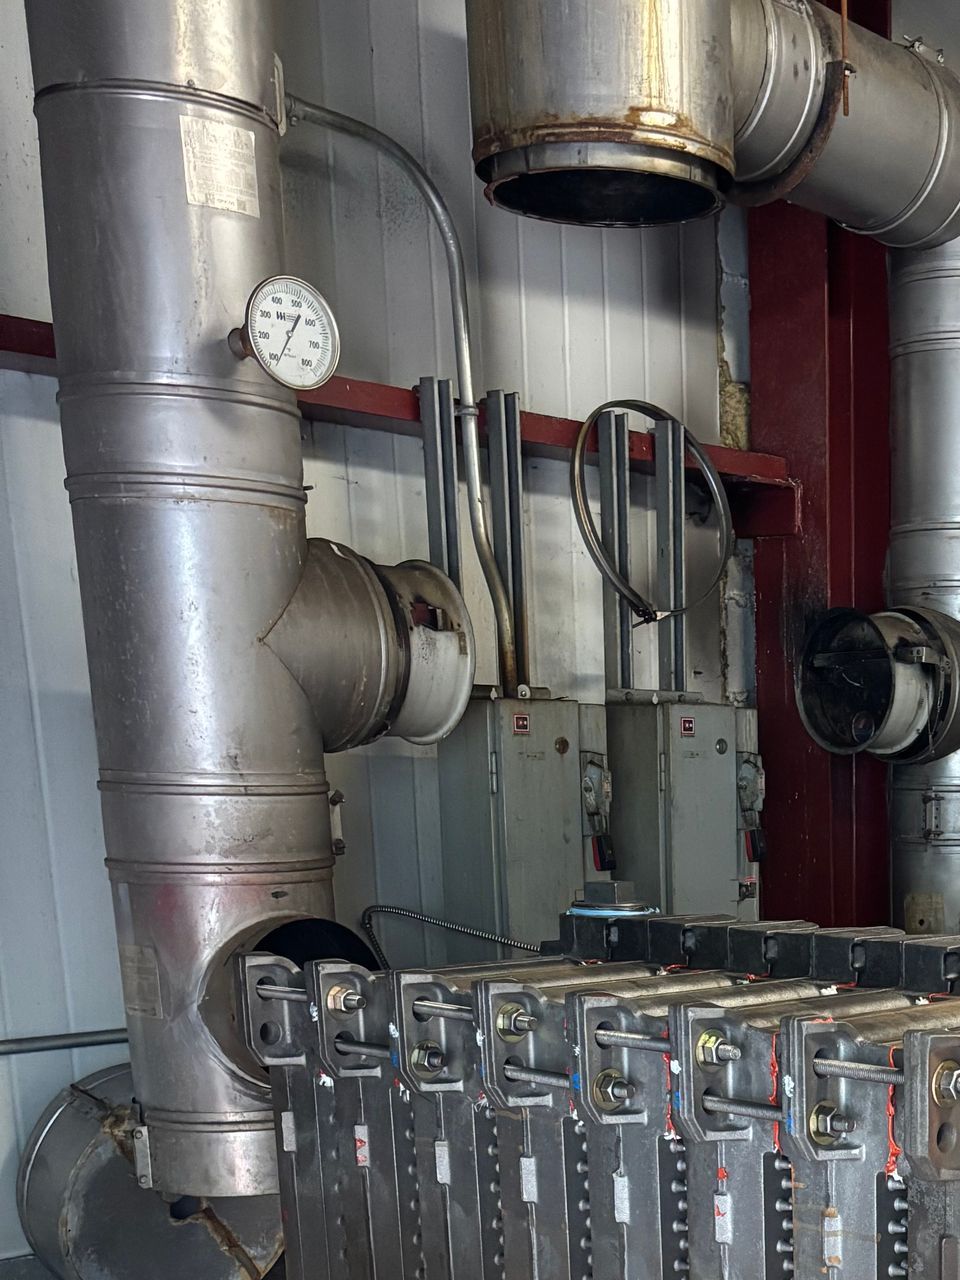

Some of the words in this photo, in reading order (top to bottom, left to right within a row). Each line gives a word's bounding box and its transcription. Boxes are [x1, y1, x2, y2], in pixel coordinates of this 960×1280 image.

[271, 296, 283, 305] 400
[291, 299, 302, 309] 500
[260, 309, 271, 319] 300
[305, 318, 316, 328] 600
[258, 331, 270, 340] 200
[309, 340, 320, 350] 700
[268, 352, 280, 361] 100
[301, 358, 313, 368] 800
